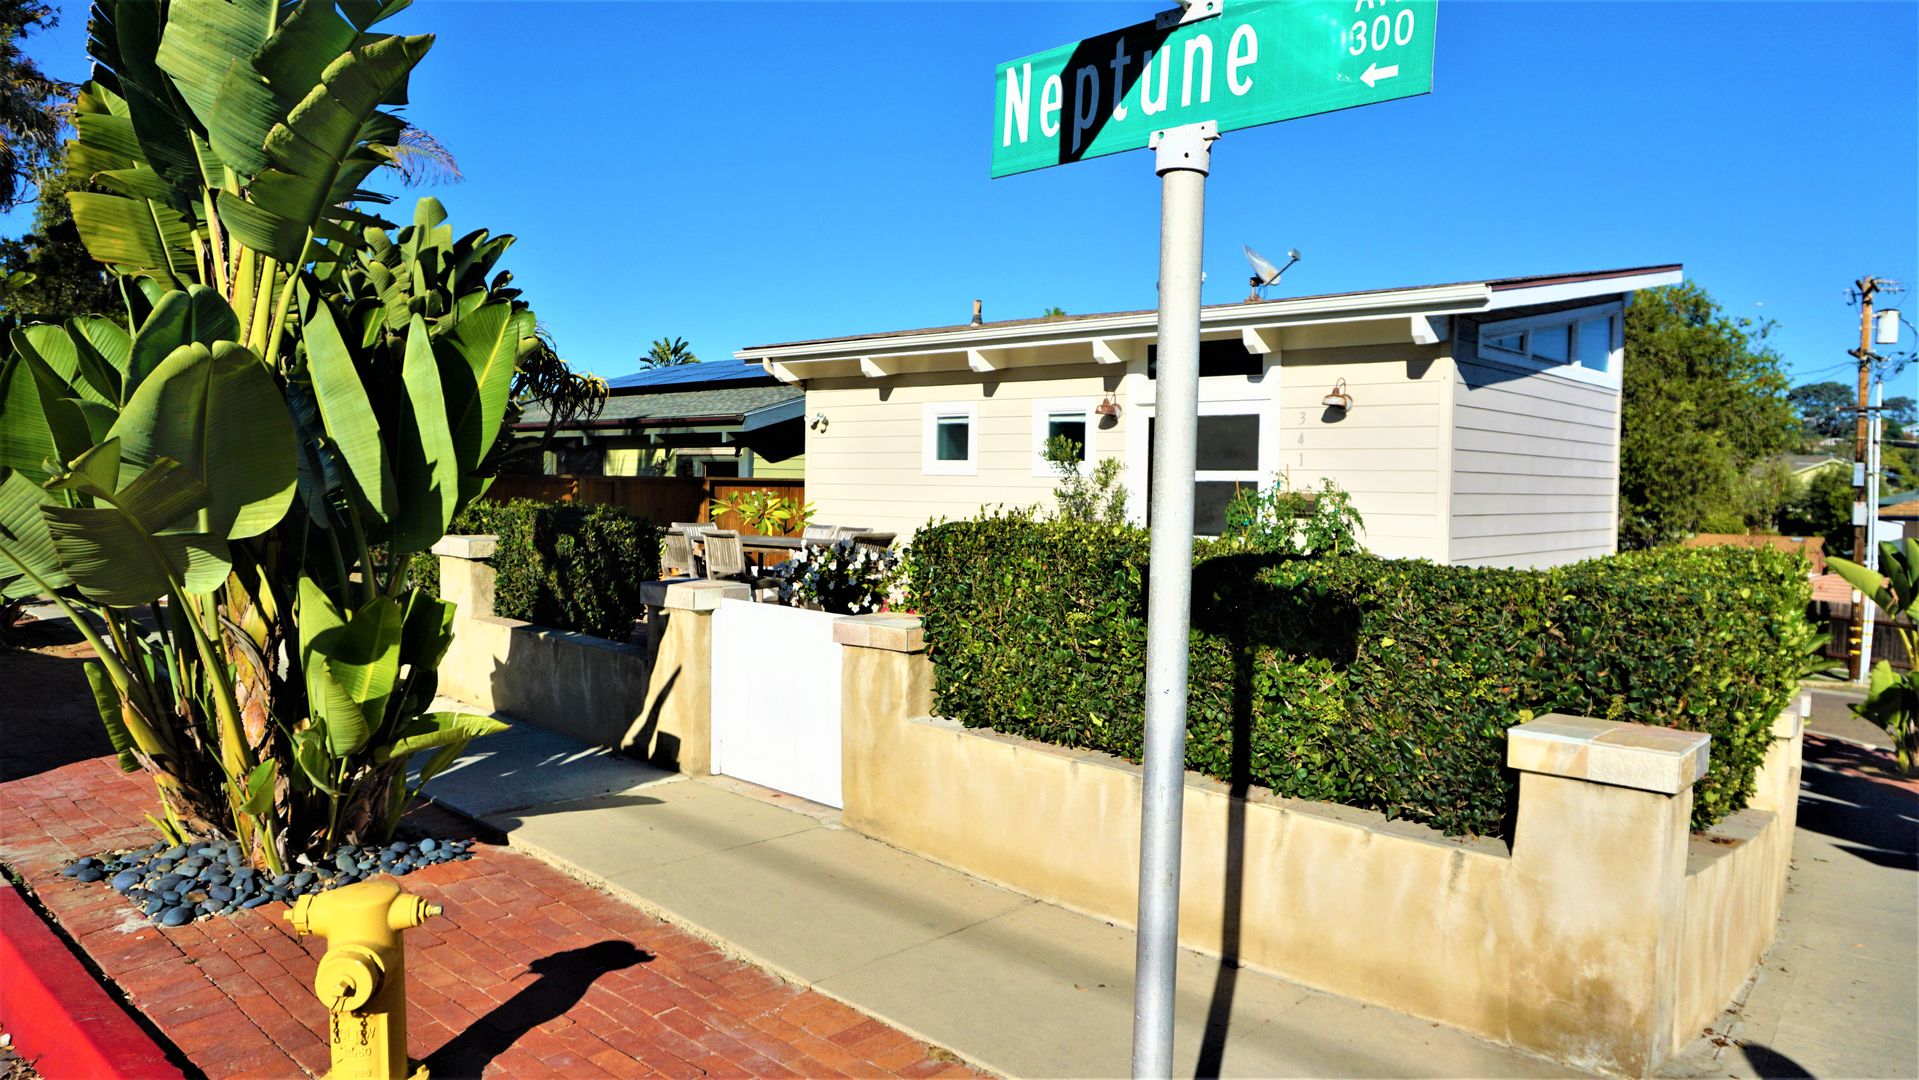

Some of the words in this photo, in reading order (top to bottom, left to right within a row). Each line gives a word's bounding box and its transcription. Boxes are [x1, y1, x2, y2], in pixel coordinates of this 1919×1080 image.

[1349, 9, 1414, 56] 300
[1003, 23, 1258, 154] Neptune
[1297, 411, 1306, 467] 341
